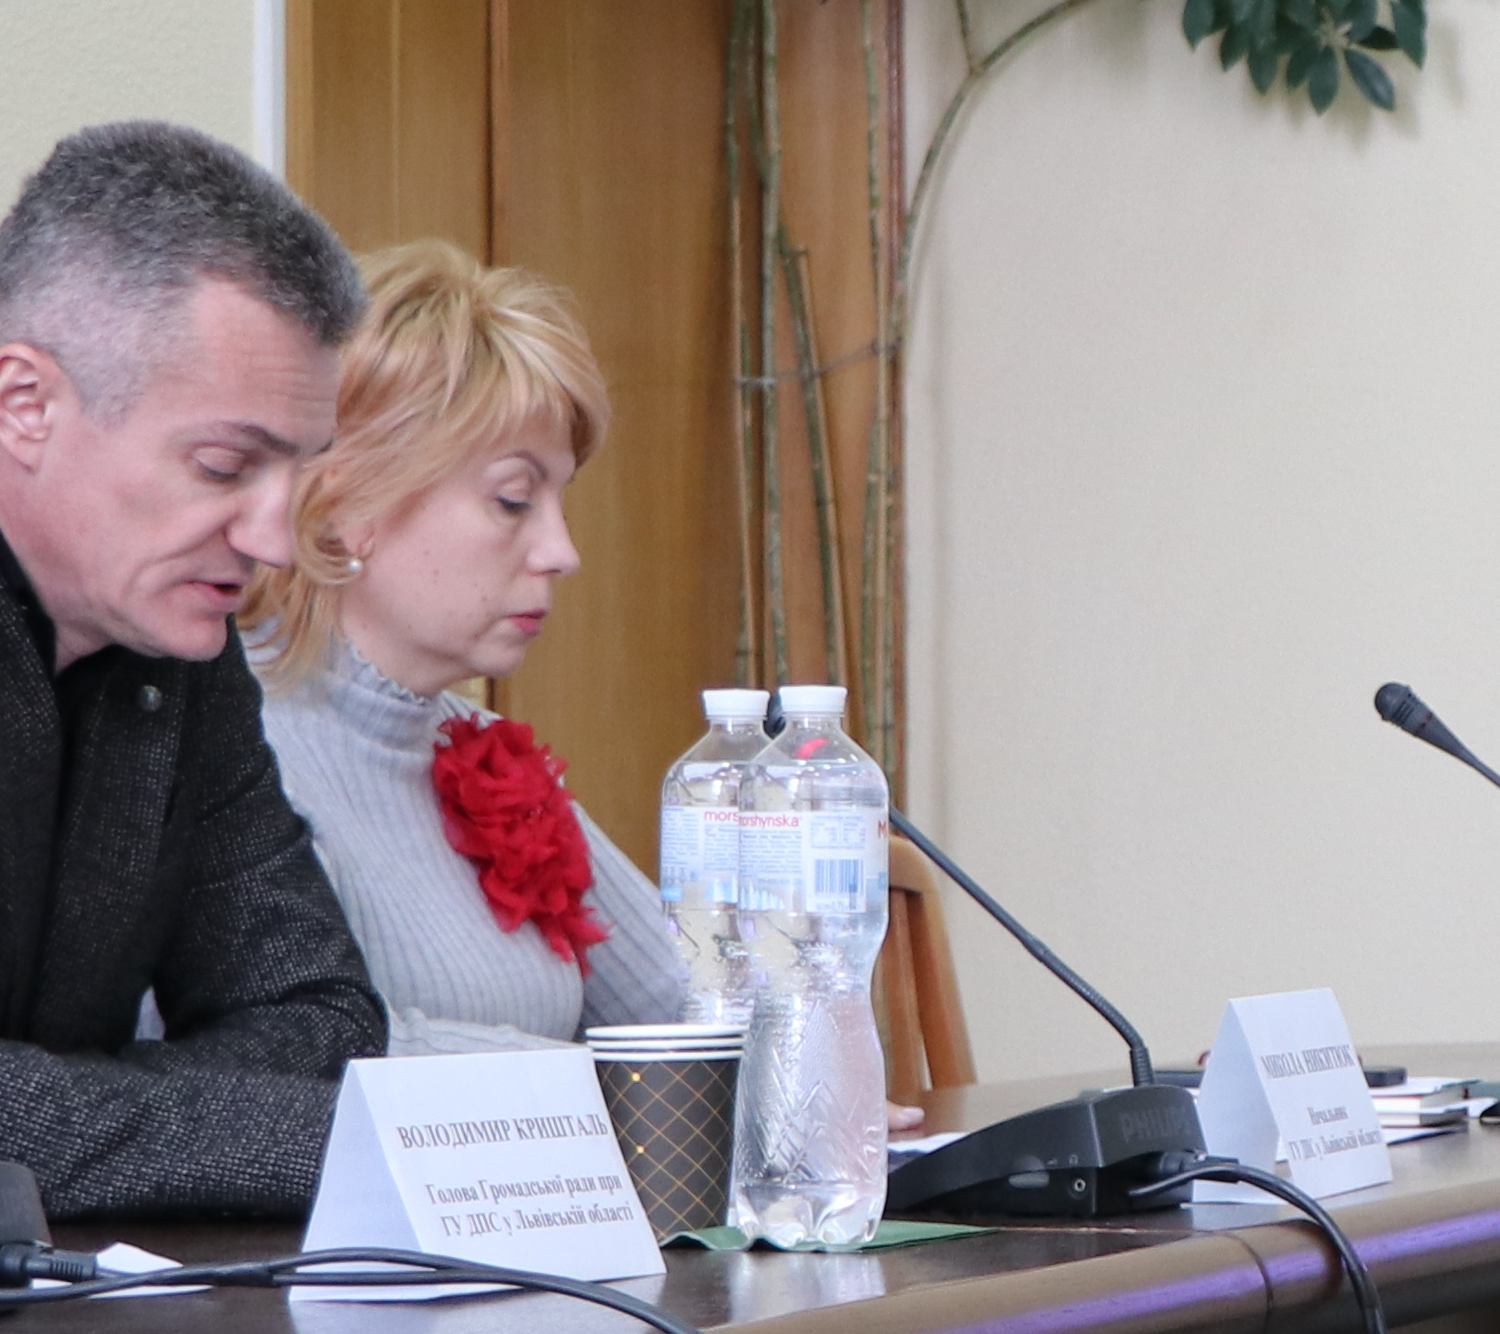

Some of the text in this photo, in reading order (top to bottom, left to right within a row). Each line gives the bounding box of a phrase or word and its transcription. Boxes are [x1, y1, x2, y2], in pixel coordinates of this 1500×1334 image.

[397, 1114, 608, 1149] ВОЛОДИМИР КРИШТАЛЬ
[426, 1174, 622, 1205] Голова Громадської ради при
[441, 1202, 634, 1237] ГУ ДПС у Львівській області
